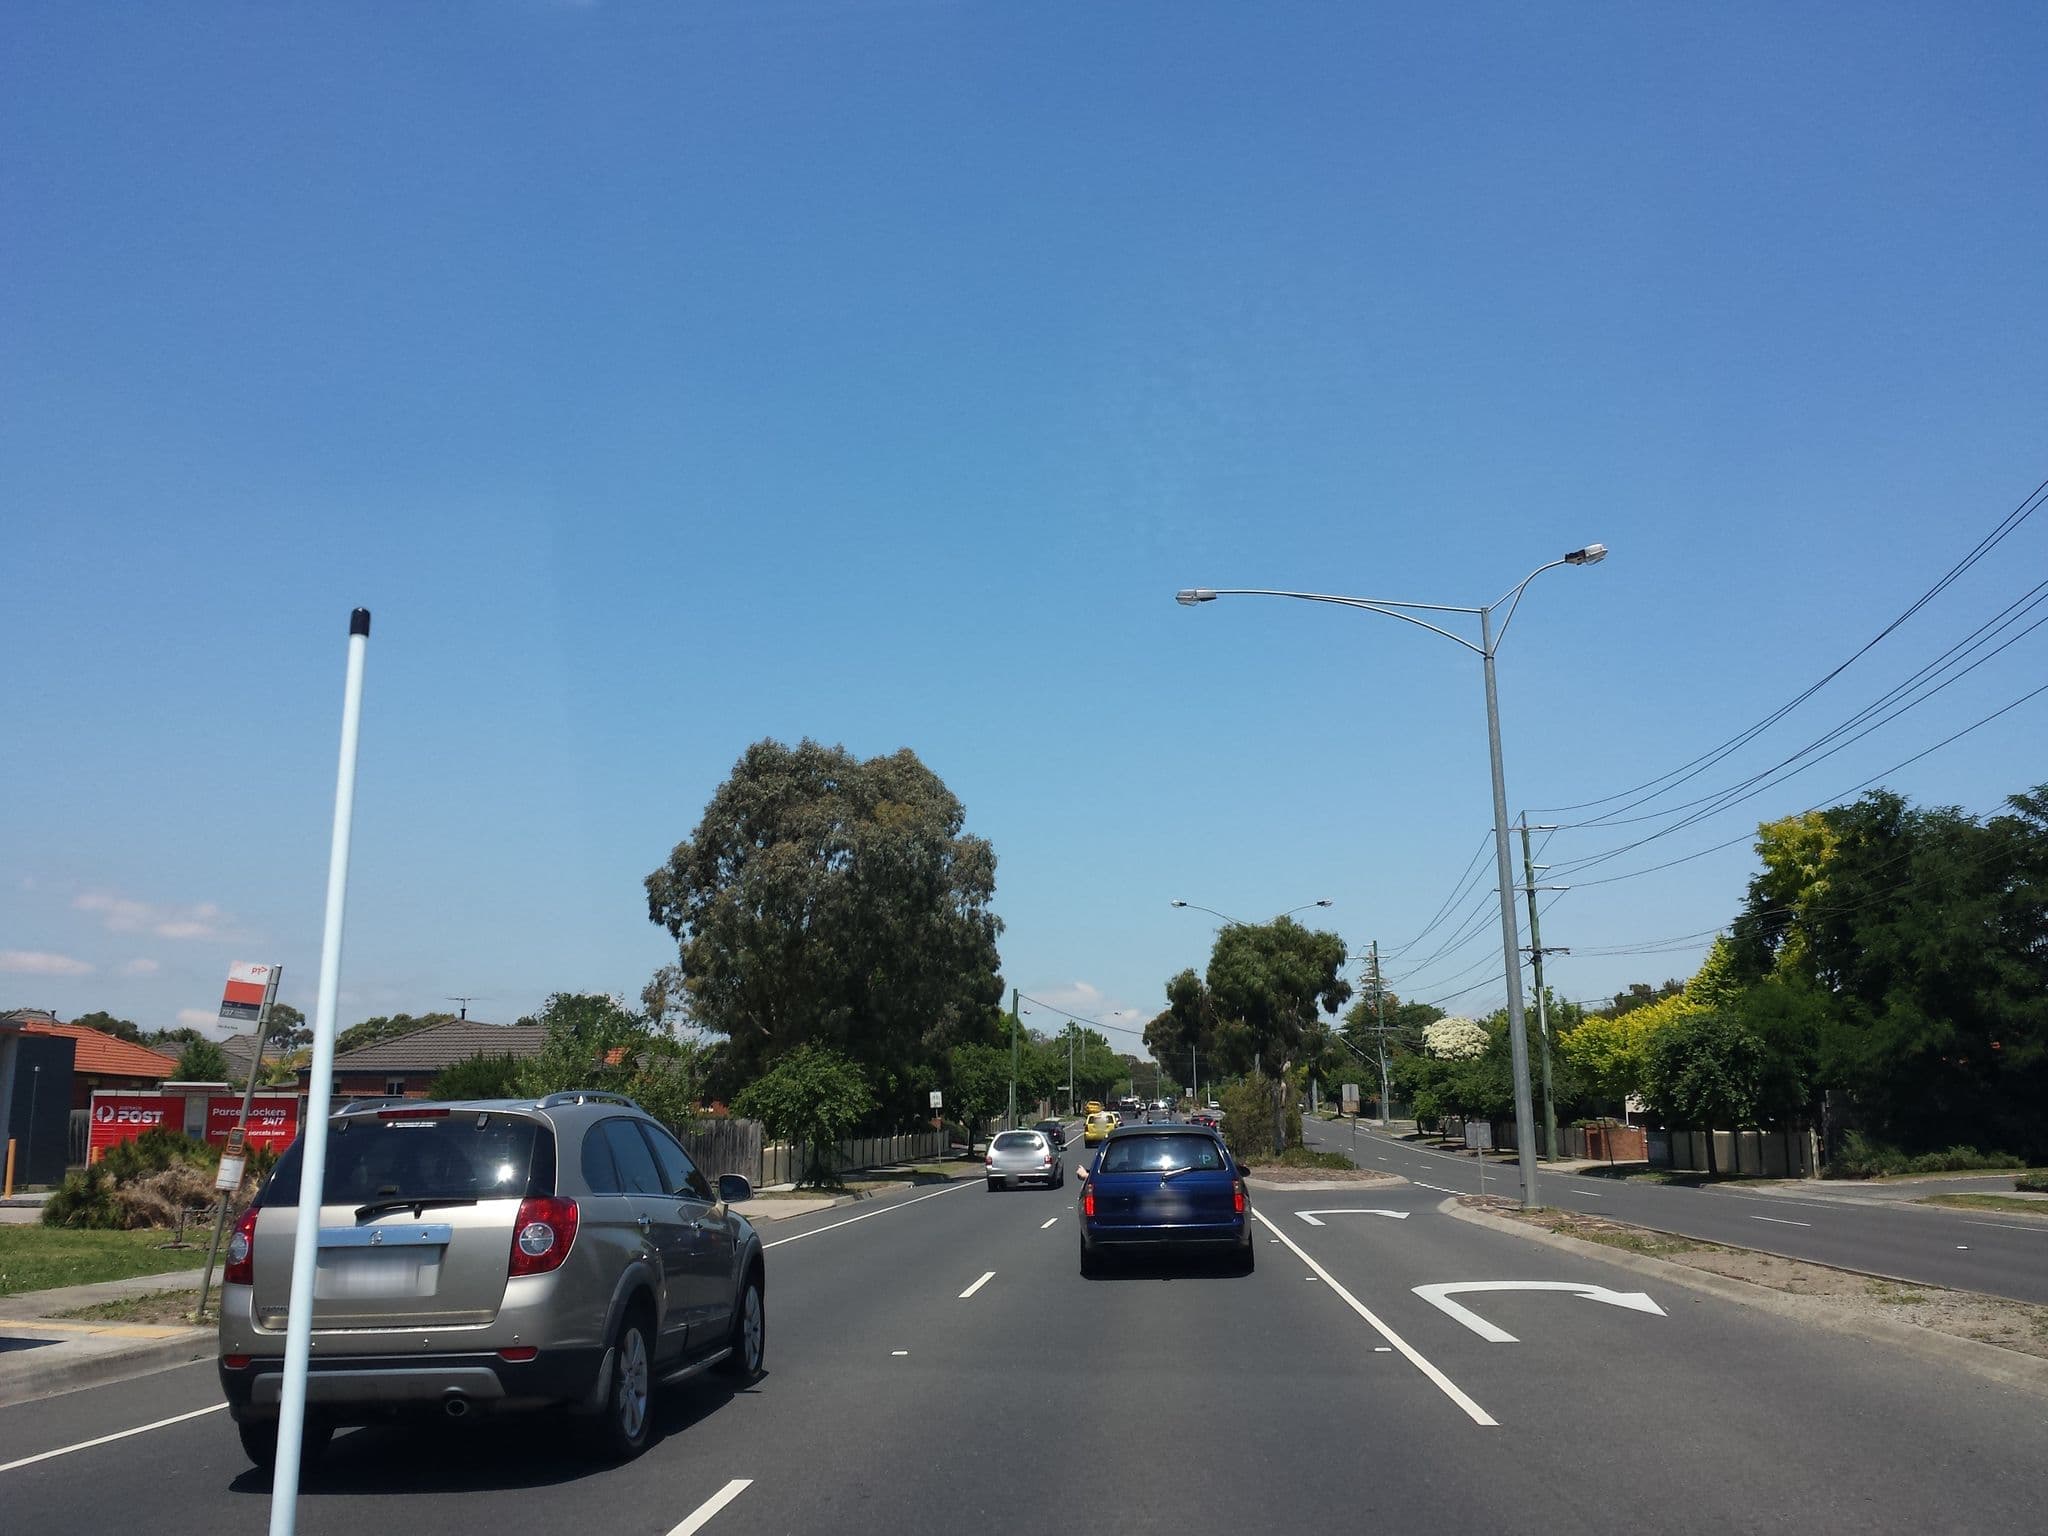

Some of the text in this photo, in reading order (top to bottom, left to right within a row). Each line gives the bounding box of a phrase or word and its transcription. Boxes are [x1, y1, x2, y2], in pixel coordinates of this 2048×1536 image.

[212, 1107, 287, 1116] Parce Lockers
[117, 1111, 164, 1124] POST
[262, 1117, 285, 1125] 24/7
